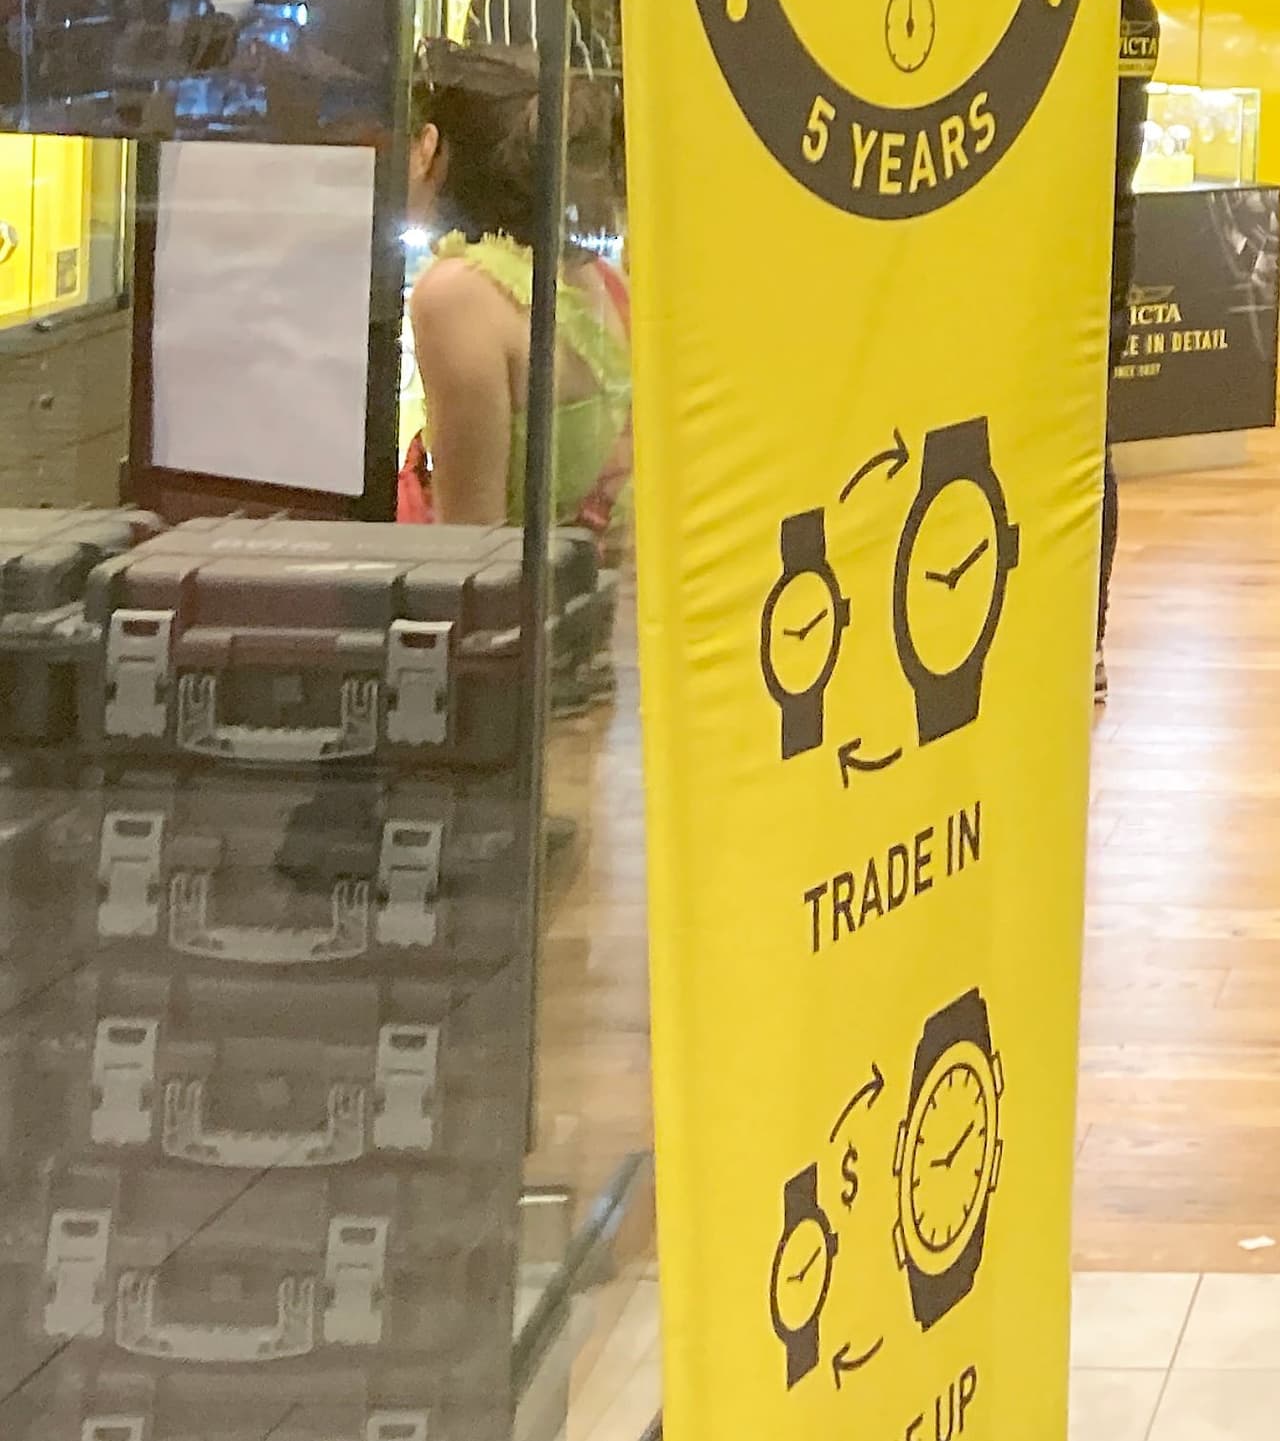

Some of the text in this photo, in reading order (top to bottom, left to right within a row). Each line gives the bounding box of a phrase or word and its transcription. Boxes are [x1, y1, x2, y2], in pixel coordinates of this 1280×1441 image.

[802, 91, 997, 196] 5 YEARS
[1171, 328, 1228, 353] DETAIL
[803, 800, 981, 953] TRADE IN
[935, 1364, 977, 1441] UP
